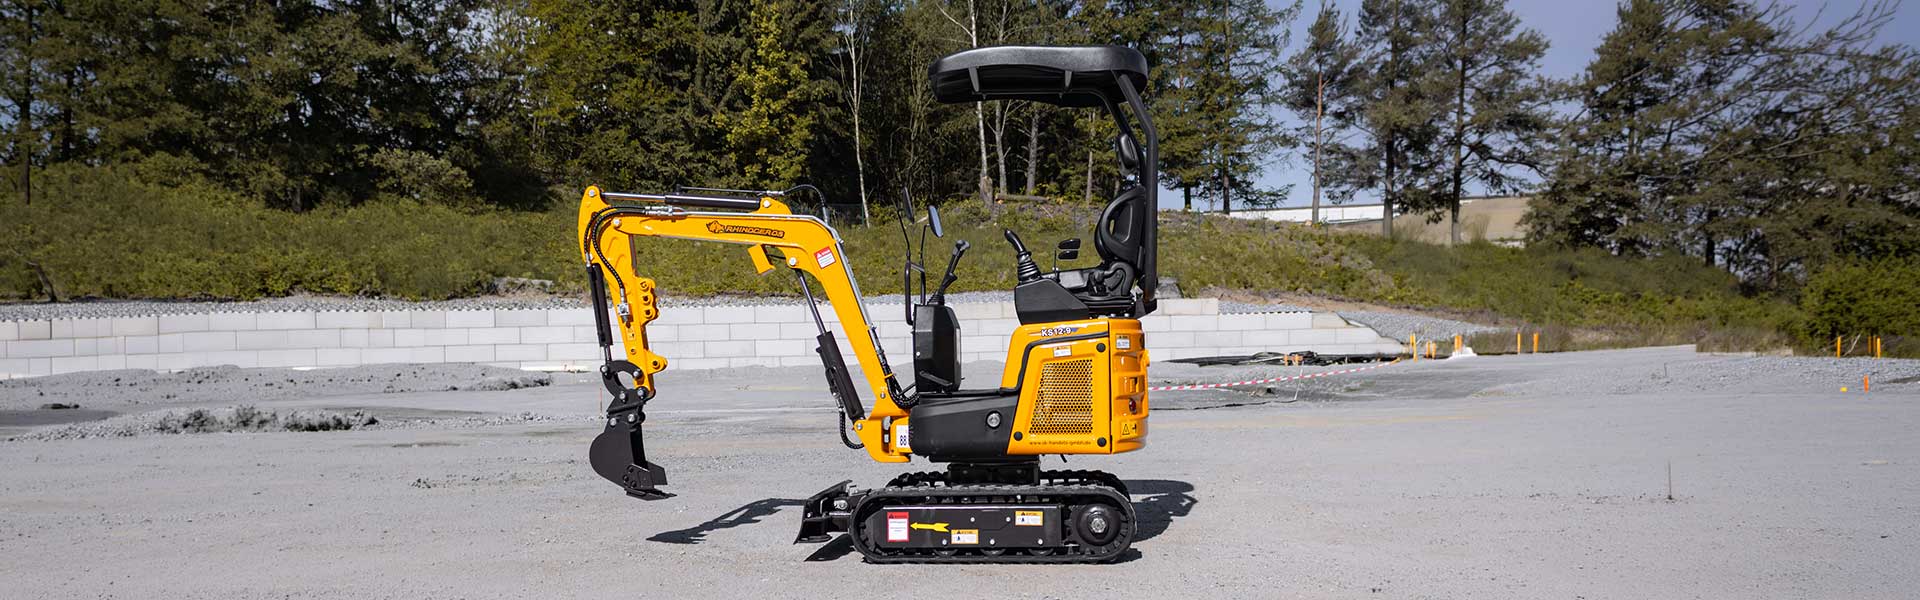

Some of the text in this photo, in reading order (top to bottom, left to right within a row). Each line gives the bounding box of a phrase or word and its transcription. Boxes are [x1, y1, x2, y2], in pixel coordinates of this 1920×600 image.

[725, 225, 784, 238] RHINOCEROS
[1041, 327, 1072, 337] KS12-9
[900, 435, 907, 446] 88
